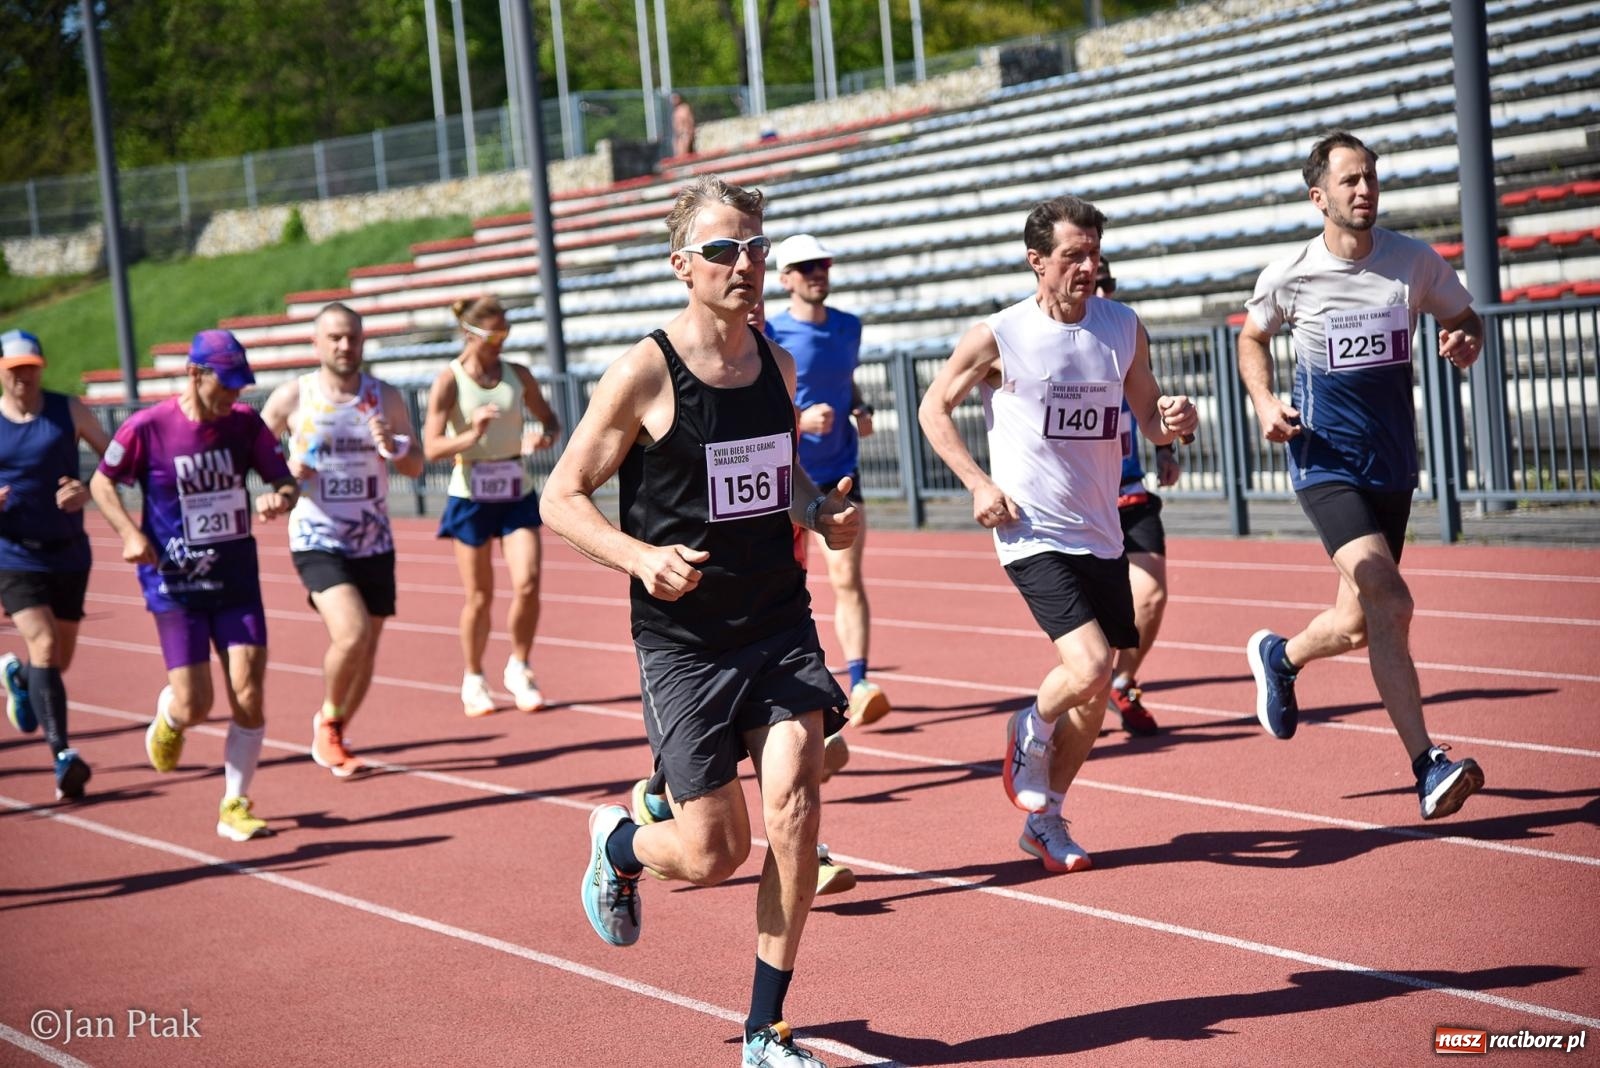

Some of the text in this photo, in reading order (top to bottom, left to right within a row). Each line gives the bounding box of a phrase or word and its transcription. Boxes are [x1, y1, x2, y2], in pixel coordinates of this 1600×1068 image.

[1339, 334, 1387, 359] 225
[1058, 408, 1098, 431] 140
[713, 441, 776, 457] XVIII BIEG BEZ GRANIC
[713, 454, 750, 466] 3MAJA2026
[328, 477, 364, 496] 238
[724, 471, 771, 506] 156
[197, 512, 230, 534] 231
